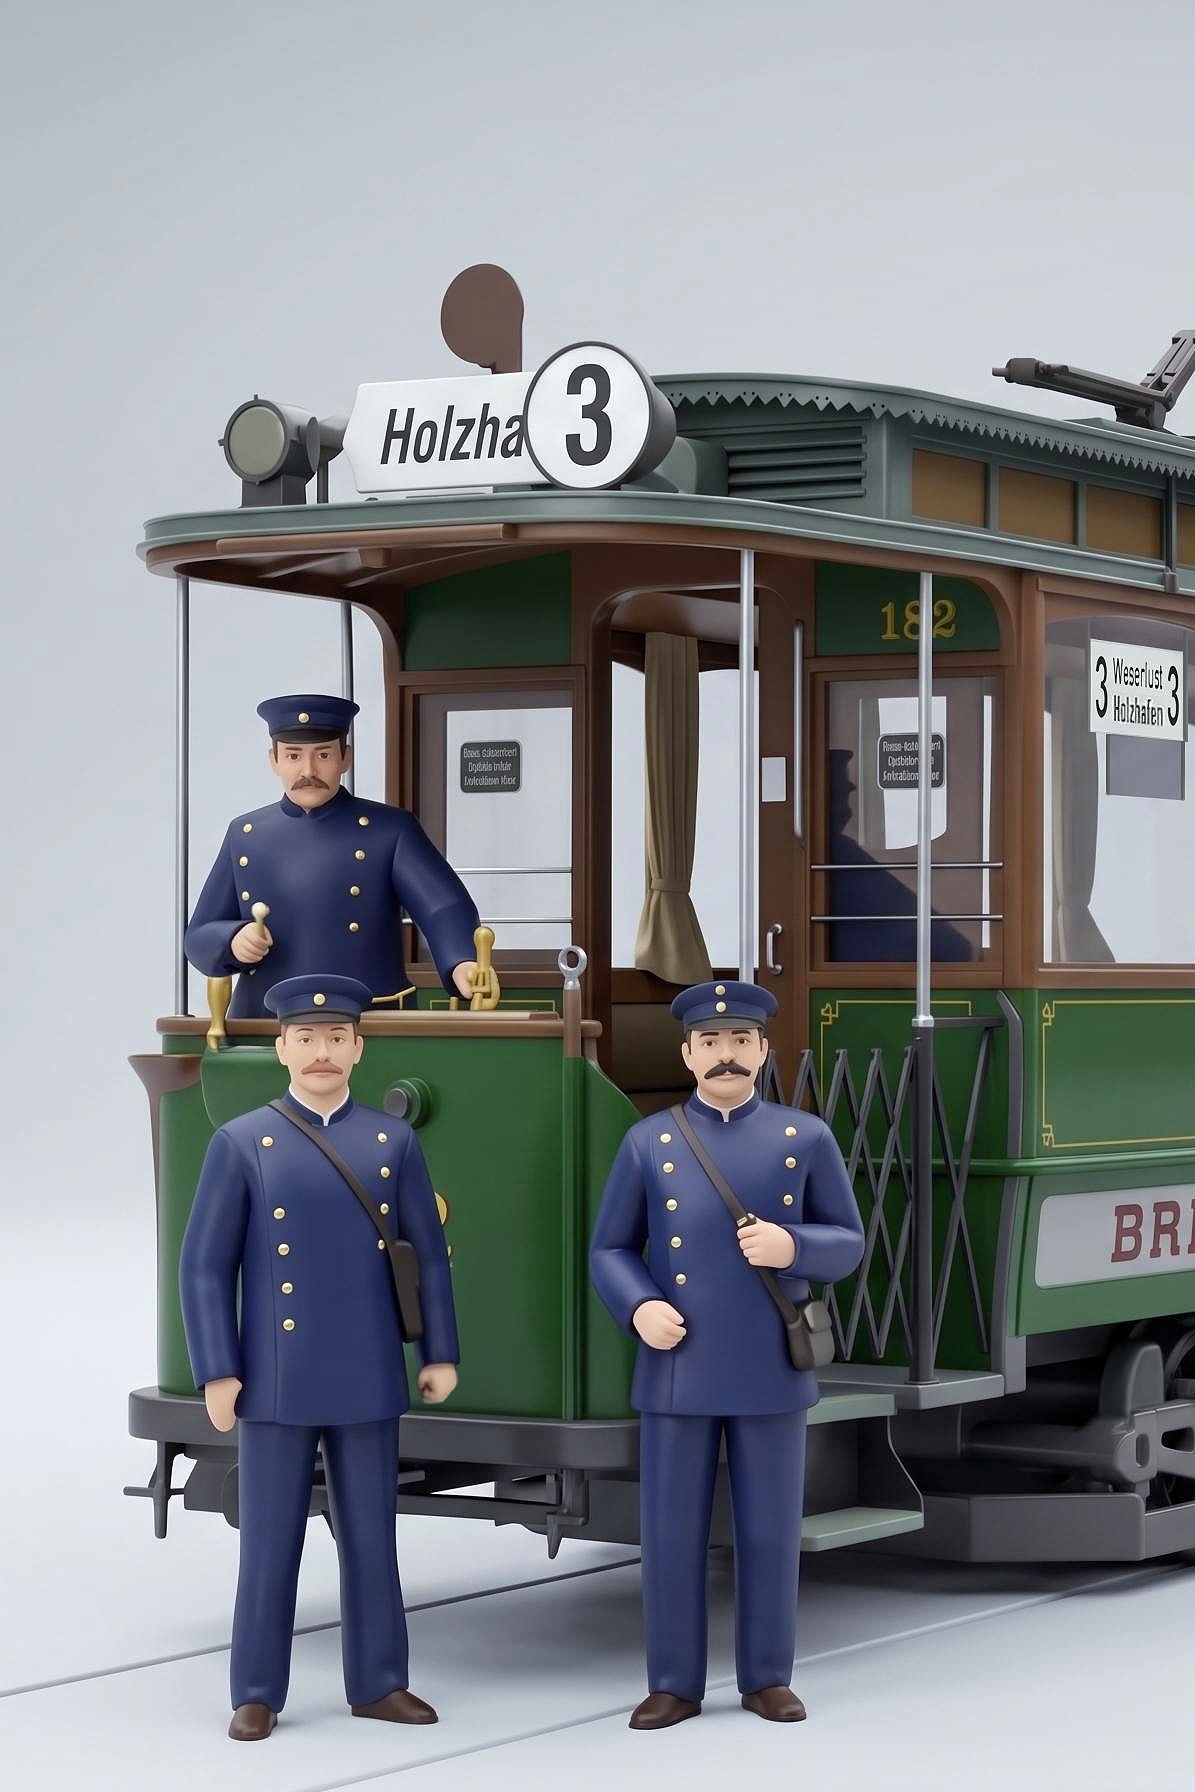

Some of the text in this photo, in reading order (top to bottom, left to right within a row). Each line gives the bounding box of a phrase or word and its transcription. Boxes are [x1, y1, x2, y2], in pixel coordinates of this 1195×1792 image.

[565, 363, 612, 466] 3
[881, 600, 956, 640] 182
[1095, 655, 1108, 718] 3
[1112, 657, 1162, 690] Weserlust
[1167, 665, 1179, 726] 3
[1113, 694, 1164, 726] Holzhafen
